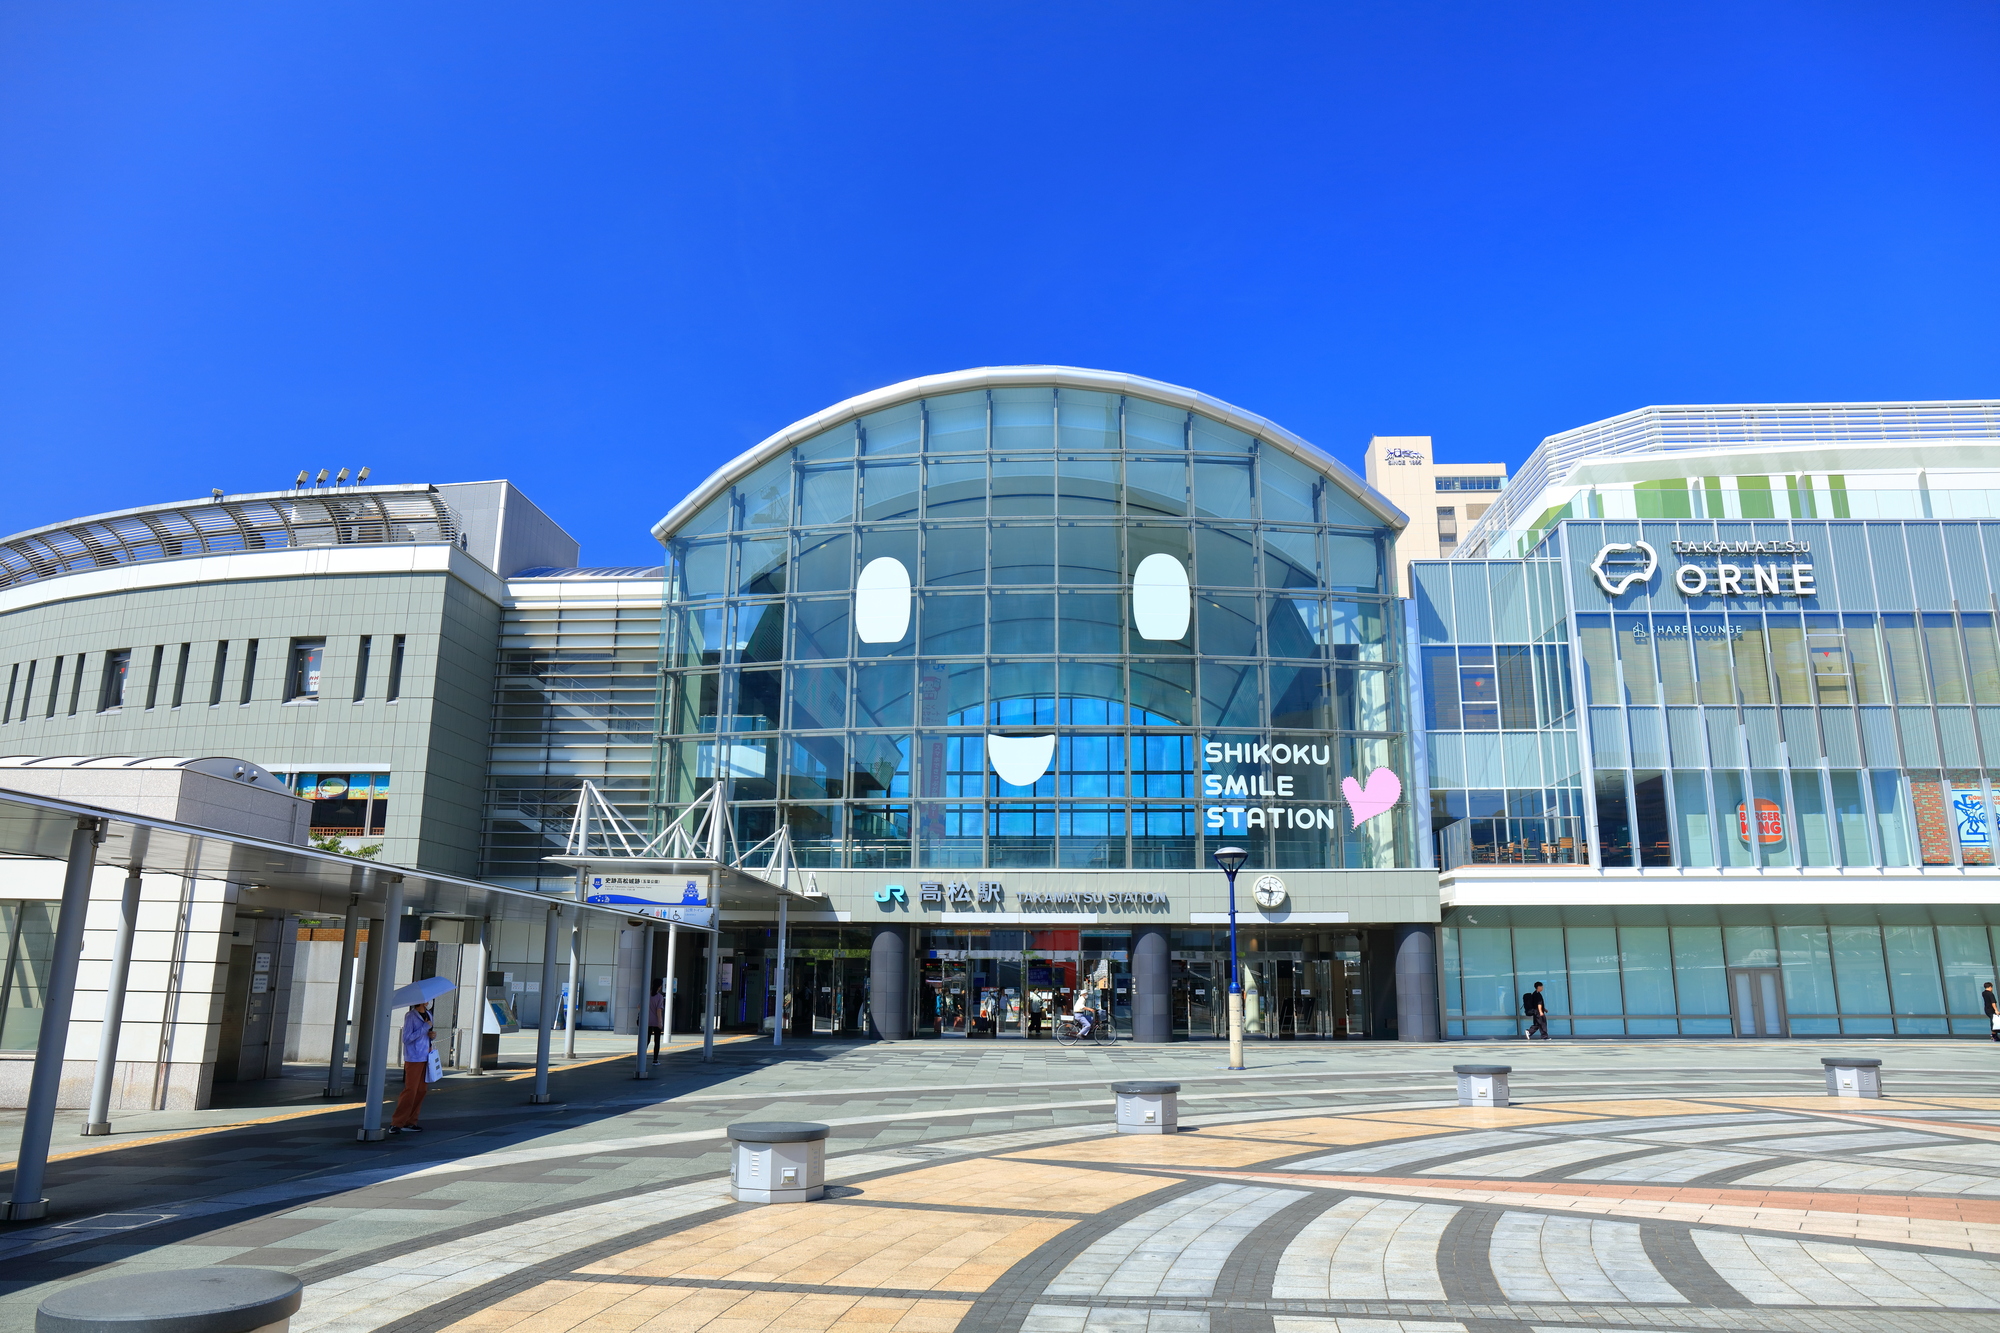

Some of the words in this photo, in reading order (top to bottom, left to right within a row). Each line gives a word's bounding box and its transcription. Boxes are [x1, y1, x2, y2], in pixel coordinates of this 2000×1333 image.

[1672, 540, 1811, 553] TAKAMATSU
[1675, 563, 1817, 595] ORNE
[1694, 625, 1742, 634] LOUNGE
[1205, 742, 1330, 765] SHIKOKU
[1205, 774, 1294, 796] SMILE
[1207, 807, 1334, 829] STATION
[1739, 812, 1781, 821] BRGER
[1741, 821, 1782, 834] KNG
[874, 884, 905, 903] JR
[919, 881, 1000, 903] 高松駅
[1016, 891, 1102, 904] TAKAMATSU
[1107, 892, 1165, 904] STATION
